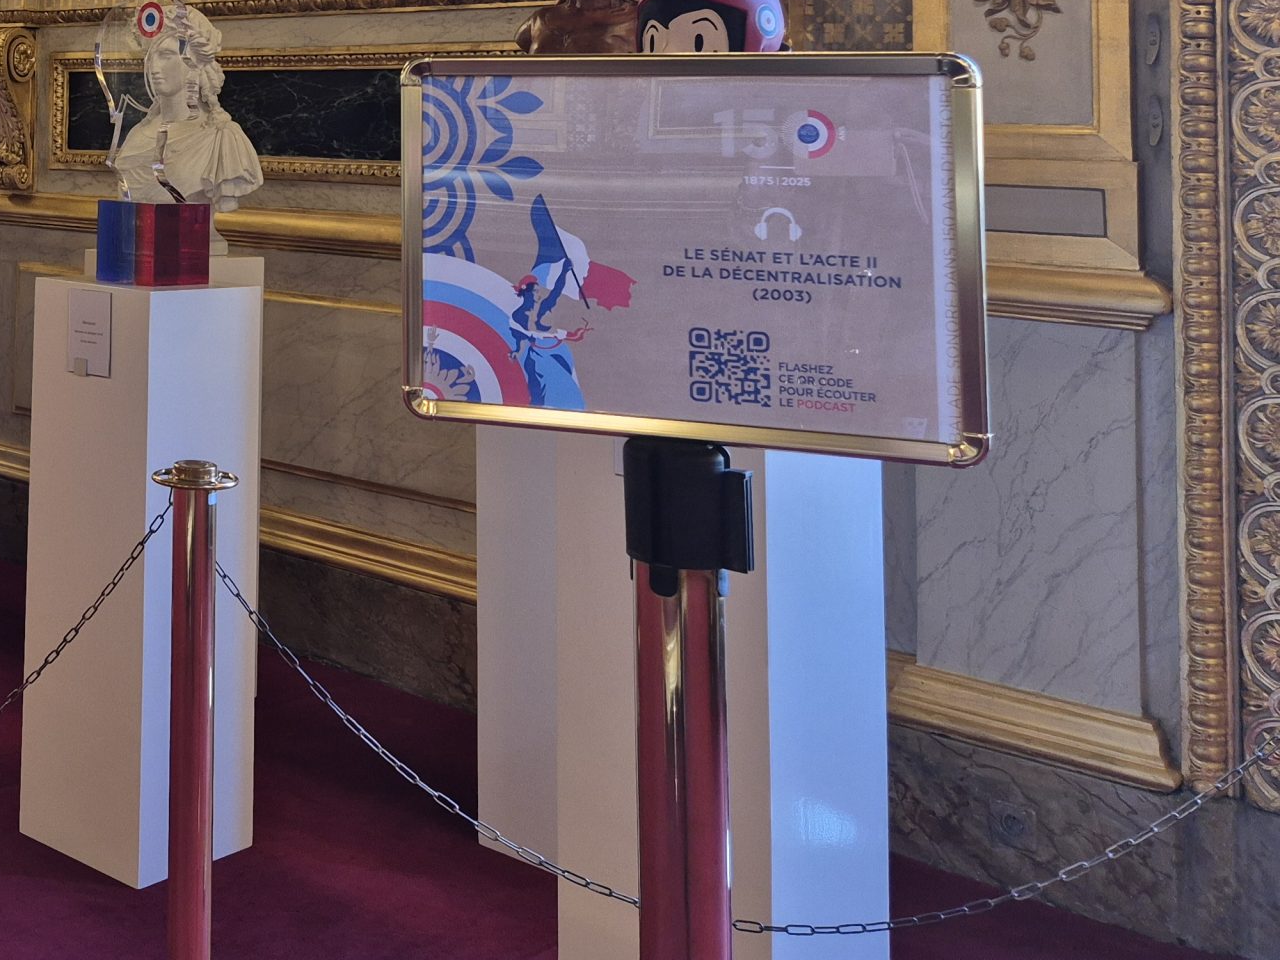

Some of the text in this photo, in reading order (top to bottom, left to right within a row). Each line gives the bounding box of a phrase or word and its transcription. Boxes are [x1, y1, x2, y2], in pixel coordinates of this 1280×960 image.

[941, 177, 955, 211] ANS
[684, 248, 705, 260] LE
[710, 247, 767, 263] SÉNAT
[772, 252, 794, 265] ET
[866, 256, 878, 269] II
[663, 265, 902, 288] DE LA DÉCENTRALISATION
[943, 247, 958, 292] DANS
[752, 288, 813, 304] (2003)
[778, 362, 833, 375] FLASHEZ
[778, 374, 853, 388] CE QR CODE
[779, 386, 876, 402] POUR ÉCOUTER
[779, 398, 856, 413] LE PODCAST
